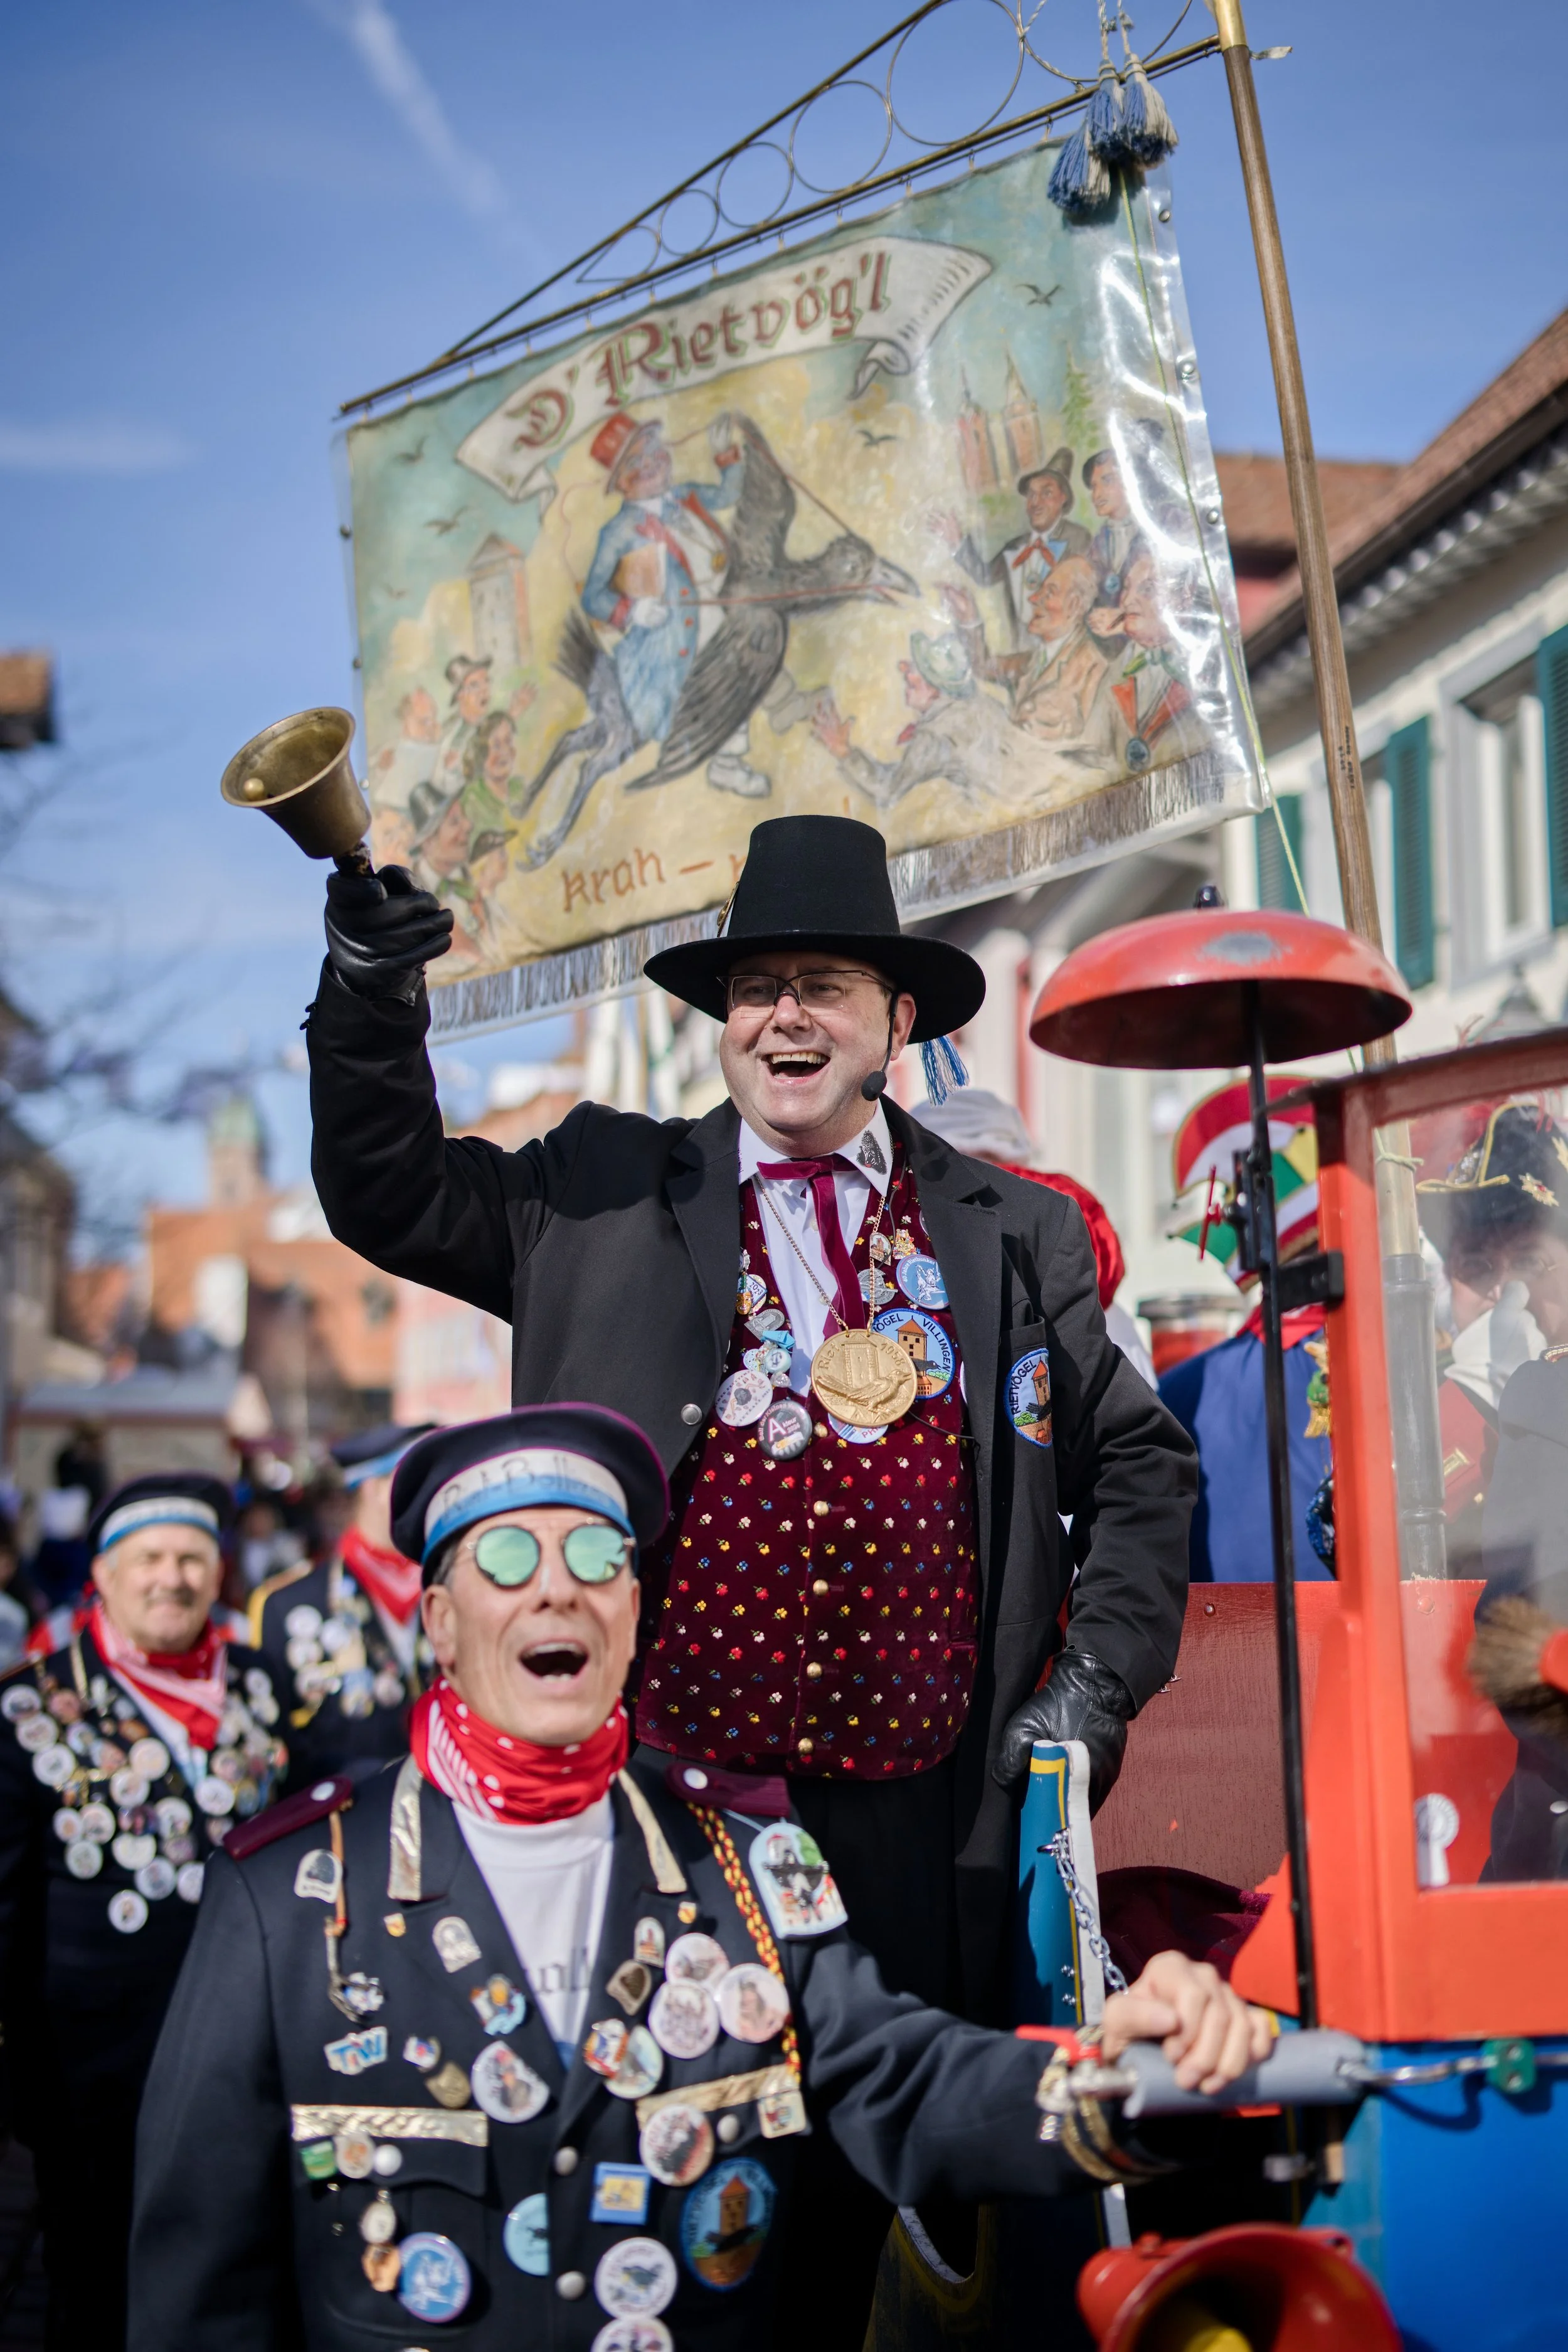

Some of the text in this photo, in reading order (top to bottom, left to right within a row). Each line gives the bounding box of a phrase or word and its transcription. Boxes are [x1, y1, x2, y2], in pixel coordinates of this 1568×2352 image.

[902, 1257, 936, 1283] 40 Jahre Rietbunker
[749, 1281, 764, 1296] 2023
[817, 1340, 907, 1370] Riet 1958
[922, 1317, 951, 1373] VILLINGEN
[1009, 1360, 1037, 1415] RIETVÖGEL
[760, 1415, 768, 1427] der
